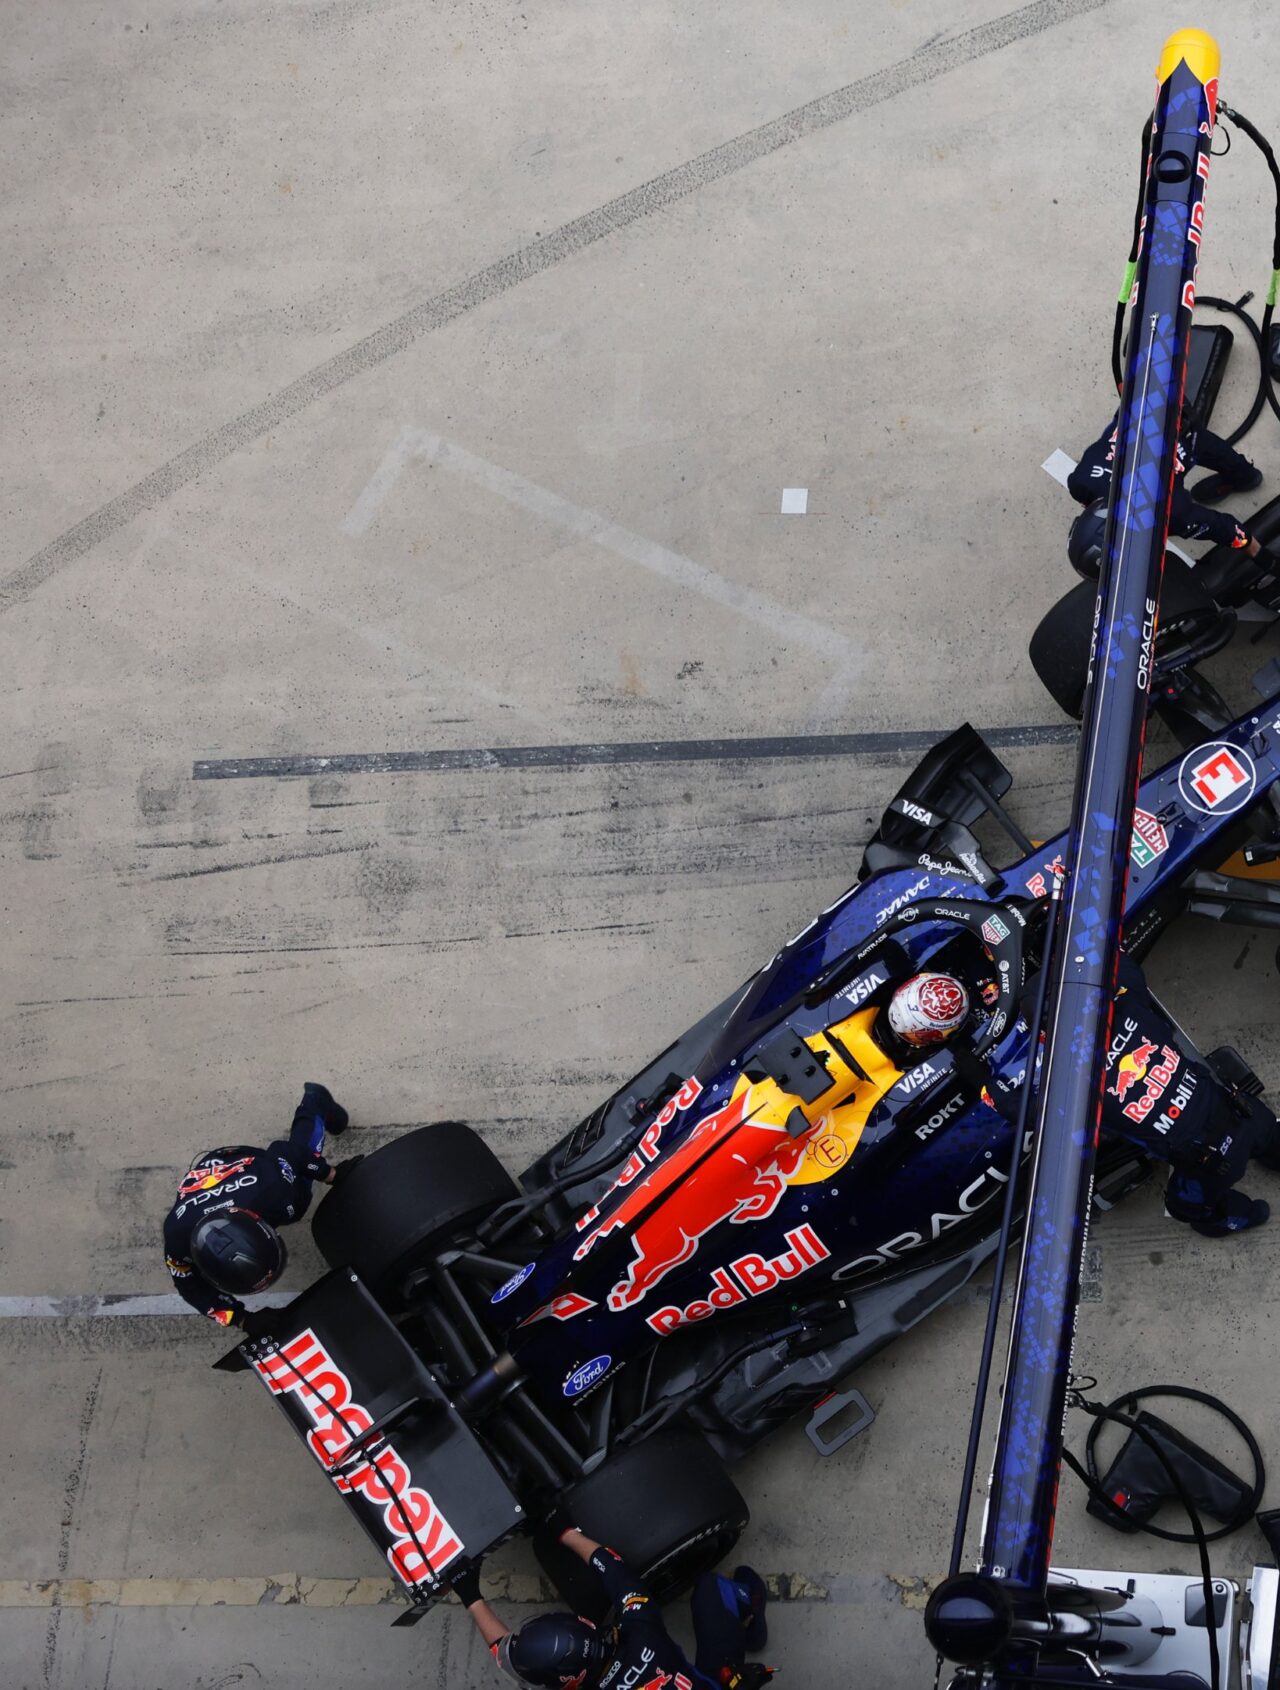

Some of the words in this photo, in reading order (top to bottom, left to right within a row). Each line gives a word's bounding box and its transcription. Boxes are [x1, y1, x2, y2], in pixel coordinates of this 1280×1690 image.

[1137, 598, 1156, 690] ORACLE
[902, 799, 933, 825] VISA
[1131, 839, 1148, 862] TA
[876, 876, 930, 925] DAMAC
[935, 907, 970, 920] ORACLE
[990, 916, 1006, 936] TAG
[846, 974, 886, 1005] VISA
[1002, 973, 1010, 994] AT&T
[1106, 1017, 1138, 1071] ACLE
[895, 1062, 935, 1094] VISA
[920, 1067, 947, 1091] INFINITE
[1122, 1076, 1165, 1124] Red
[638, 1075, 704, 1162] Red
[914, 1092, 965, 1140] ROKT
[1153, 1084, 1193, 1135] Mobil
[175, 1175, 257, 1219] ORACLE
[645, 1267, 747, 1337] Red
[729, 1222, 832, 1296] Bull
[570, 1360, 607, 1392] Ford
[252, 1327, 385, 1472] Bull
[331, 1444, 465, 1587] Red
